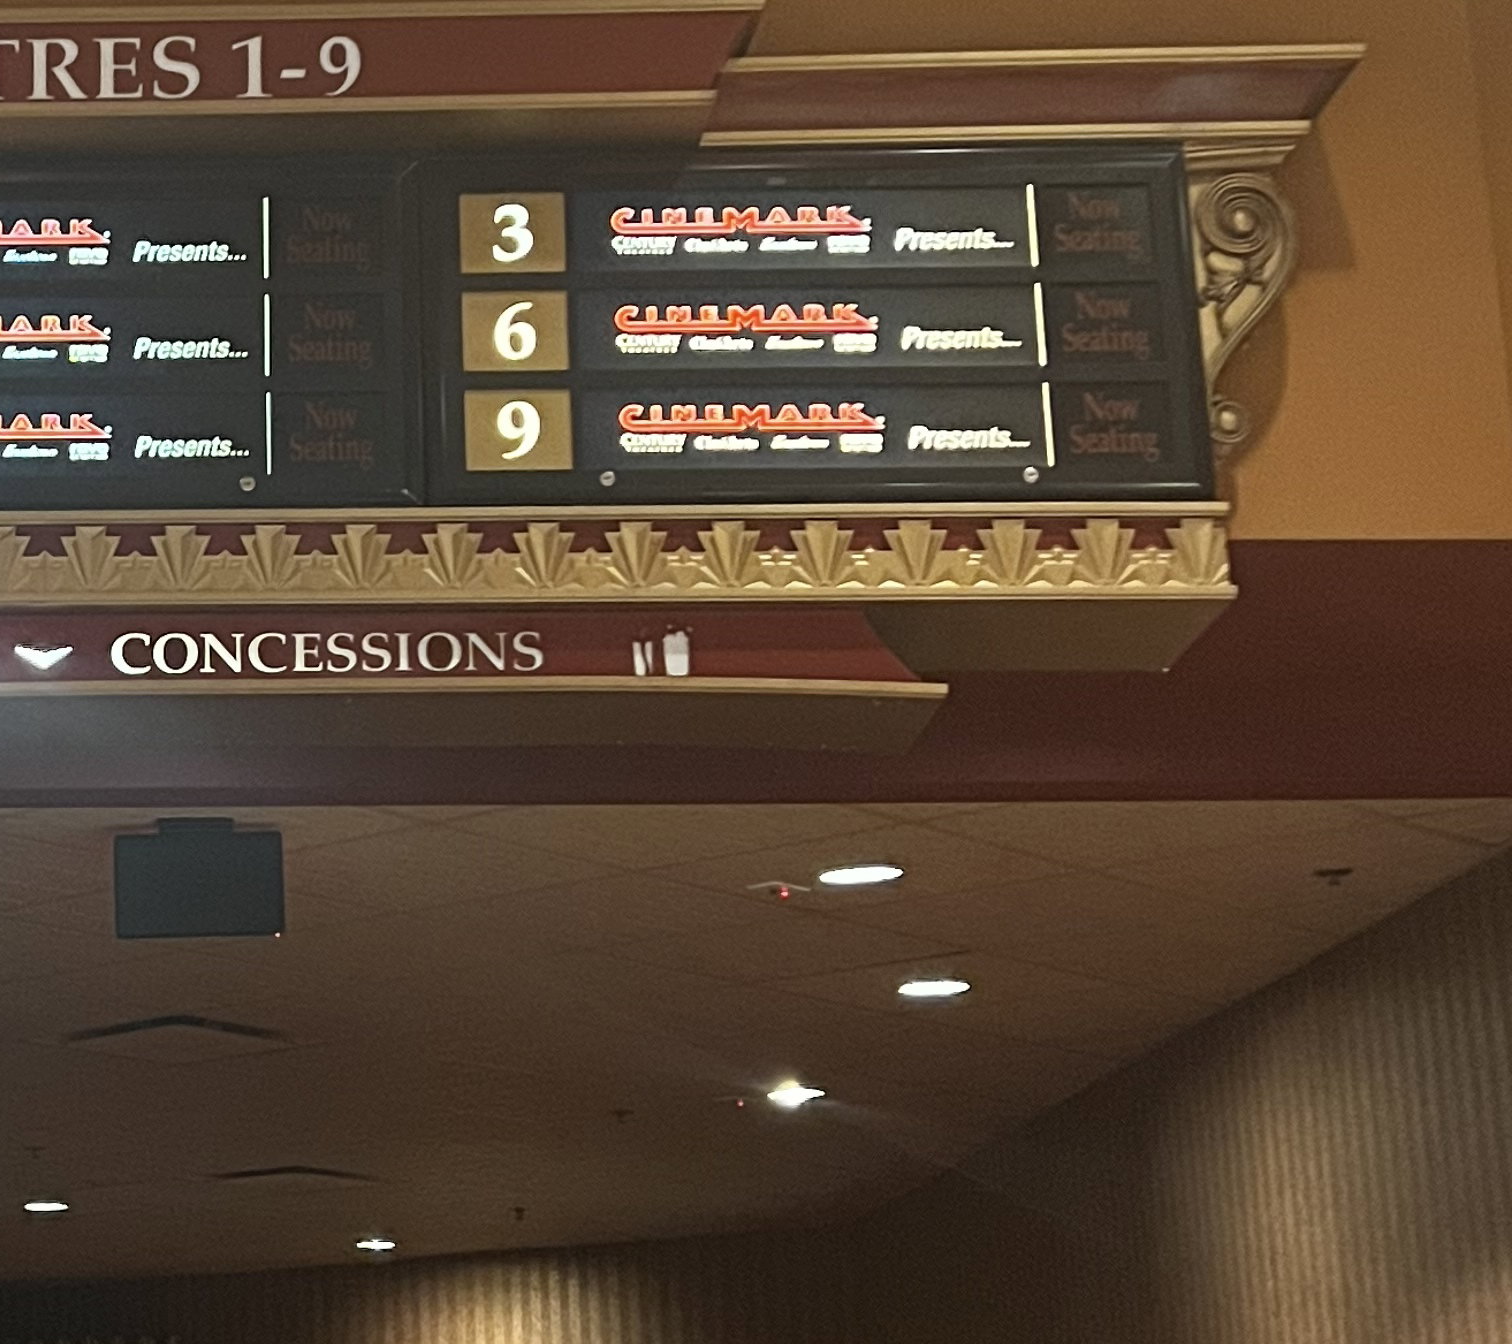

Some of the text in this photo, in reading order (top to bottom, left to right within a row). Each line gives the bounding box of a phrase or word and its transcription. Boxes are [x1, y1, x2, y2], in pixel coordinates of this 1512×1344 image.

[231, 36, 363, 98] 1-9
[493, 205, 533, 262] 3
[610, 206, 860, 234] CINEMARK
[494, 302, 536, 360] 6
[614, 304, 867, 332] CINEMARK
[497, 401, 540, 459] 9
[618, 403, 873, 431] CINEMARK
[110, 631, 544, 676] CONCESSIONS
